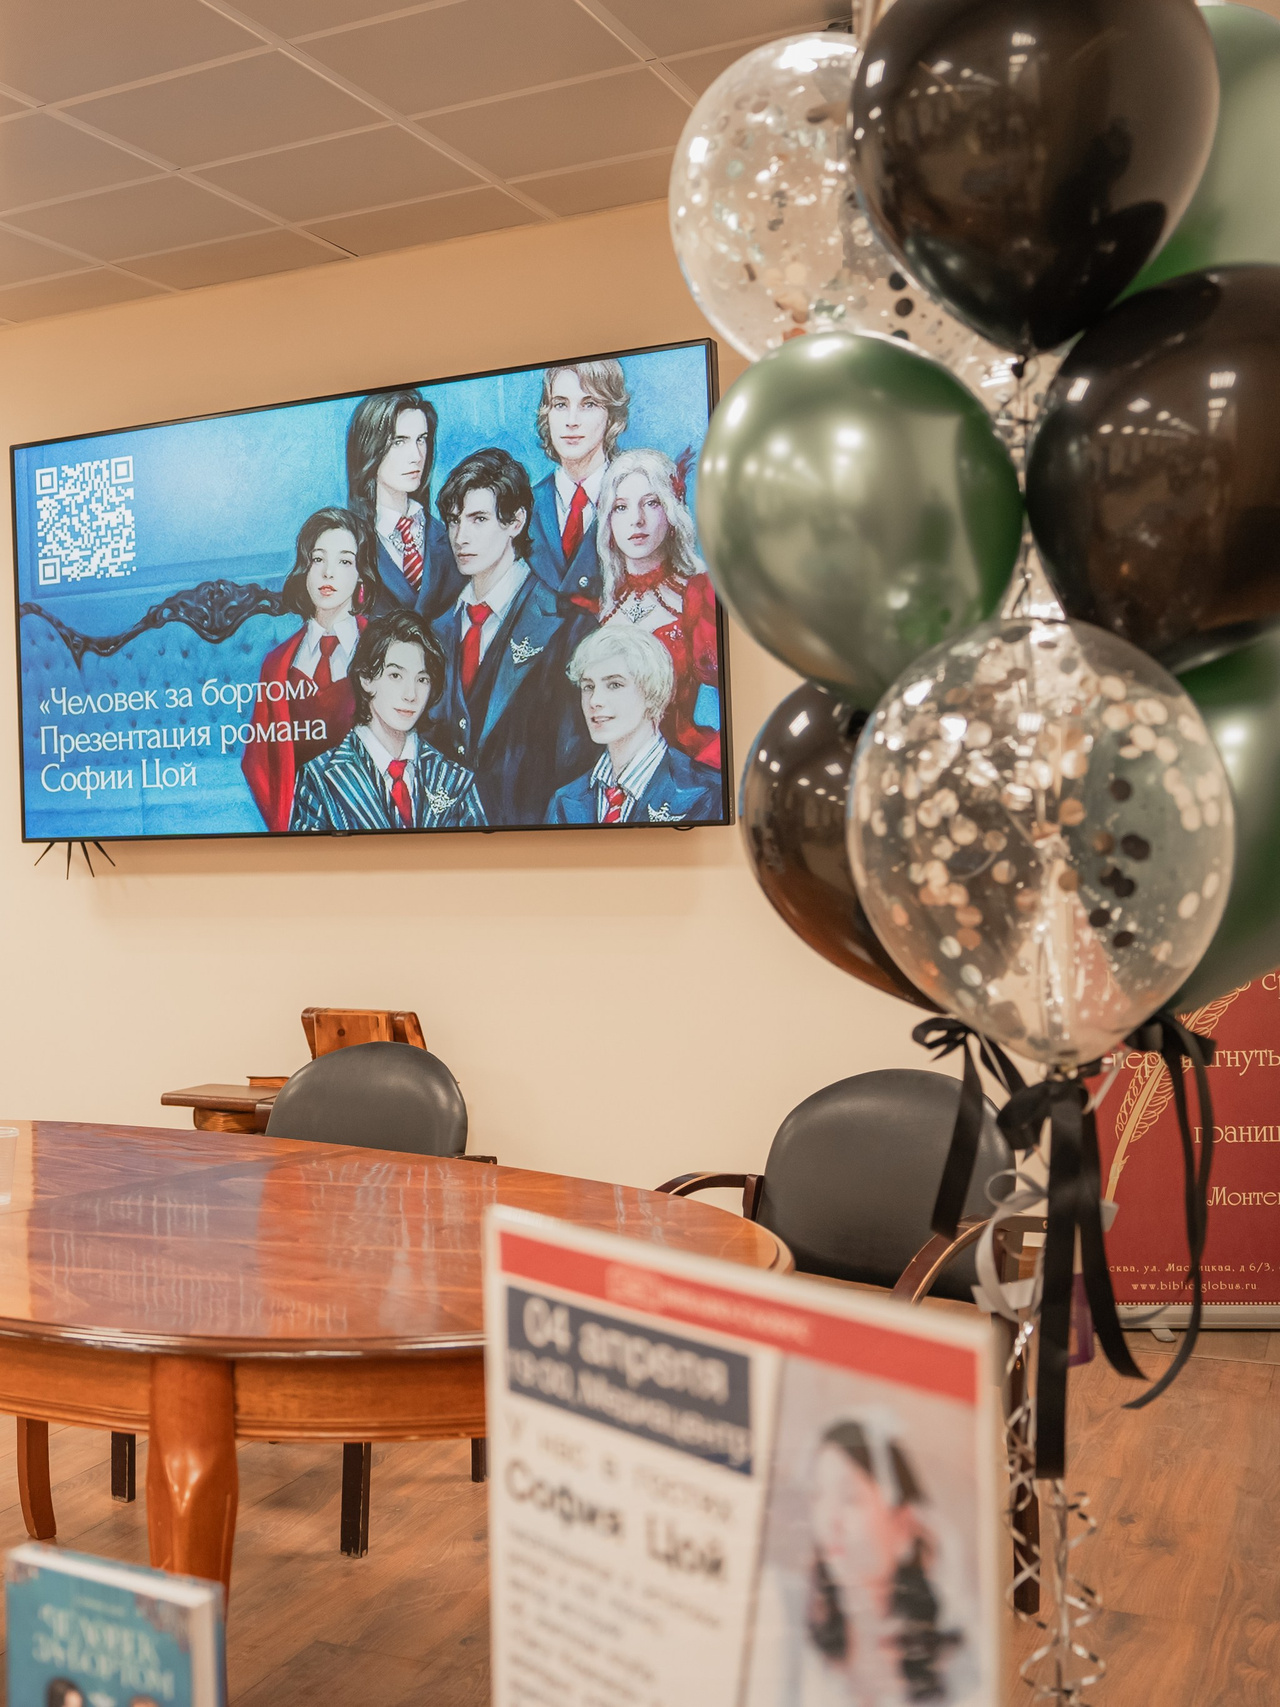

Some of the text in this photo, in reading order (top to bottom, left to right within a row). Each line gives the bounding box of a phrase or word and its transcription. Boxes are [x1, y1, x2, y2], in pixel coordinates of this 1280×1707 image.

[39, 678, 319, 716] «Человек за бортом»
[40, 718, 328, 762] Презентация романа
[41, 758, 198, 800] Софии Цой
[1111, 1049, 1280, 1077] пергнуть
[1131, 1280, 1257, 1294] www.biblioglobus.ru
[523, 1296, 572, 1353] 04
[578, 1321, 729, 1405] апреля
[504, 1457, 728, 1582] София Цой
